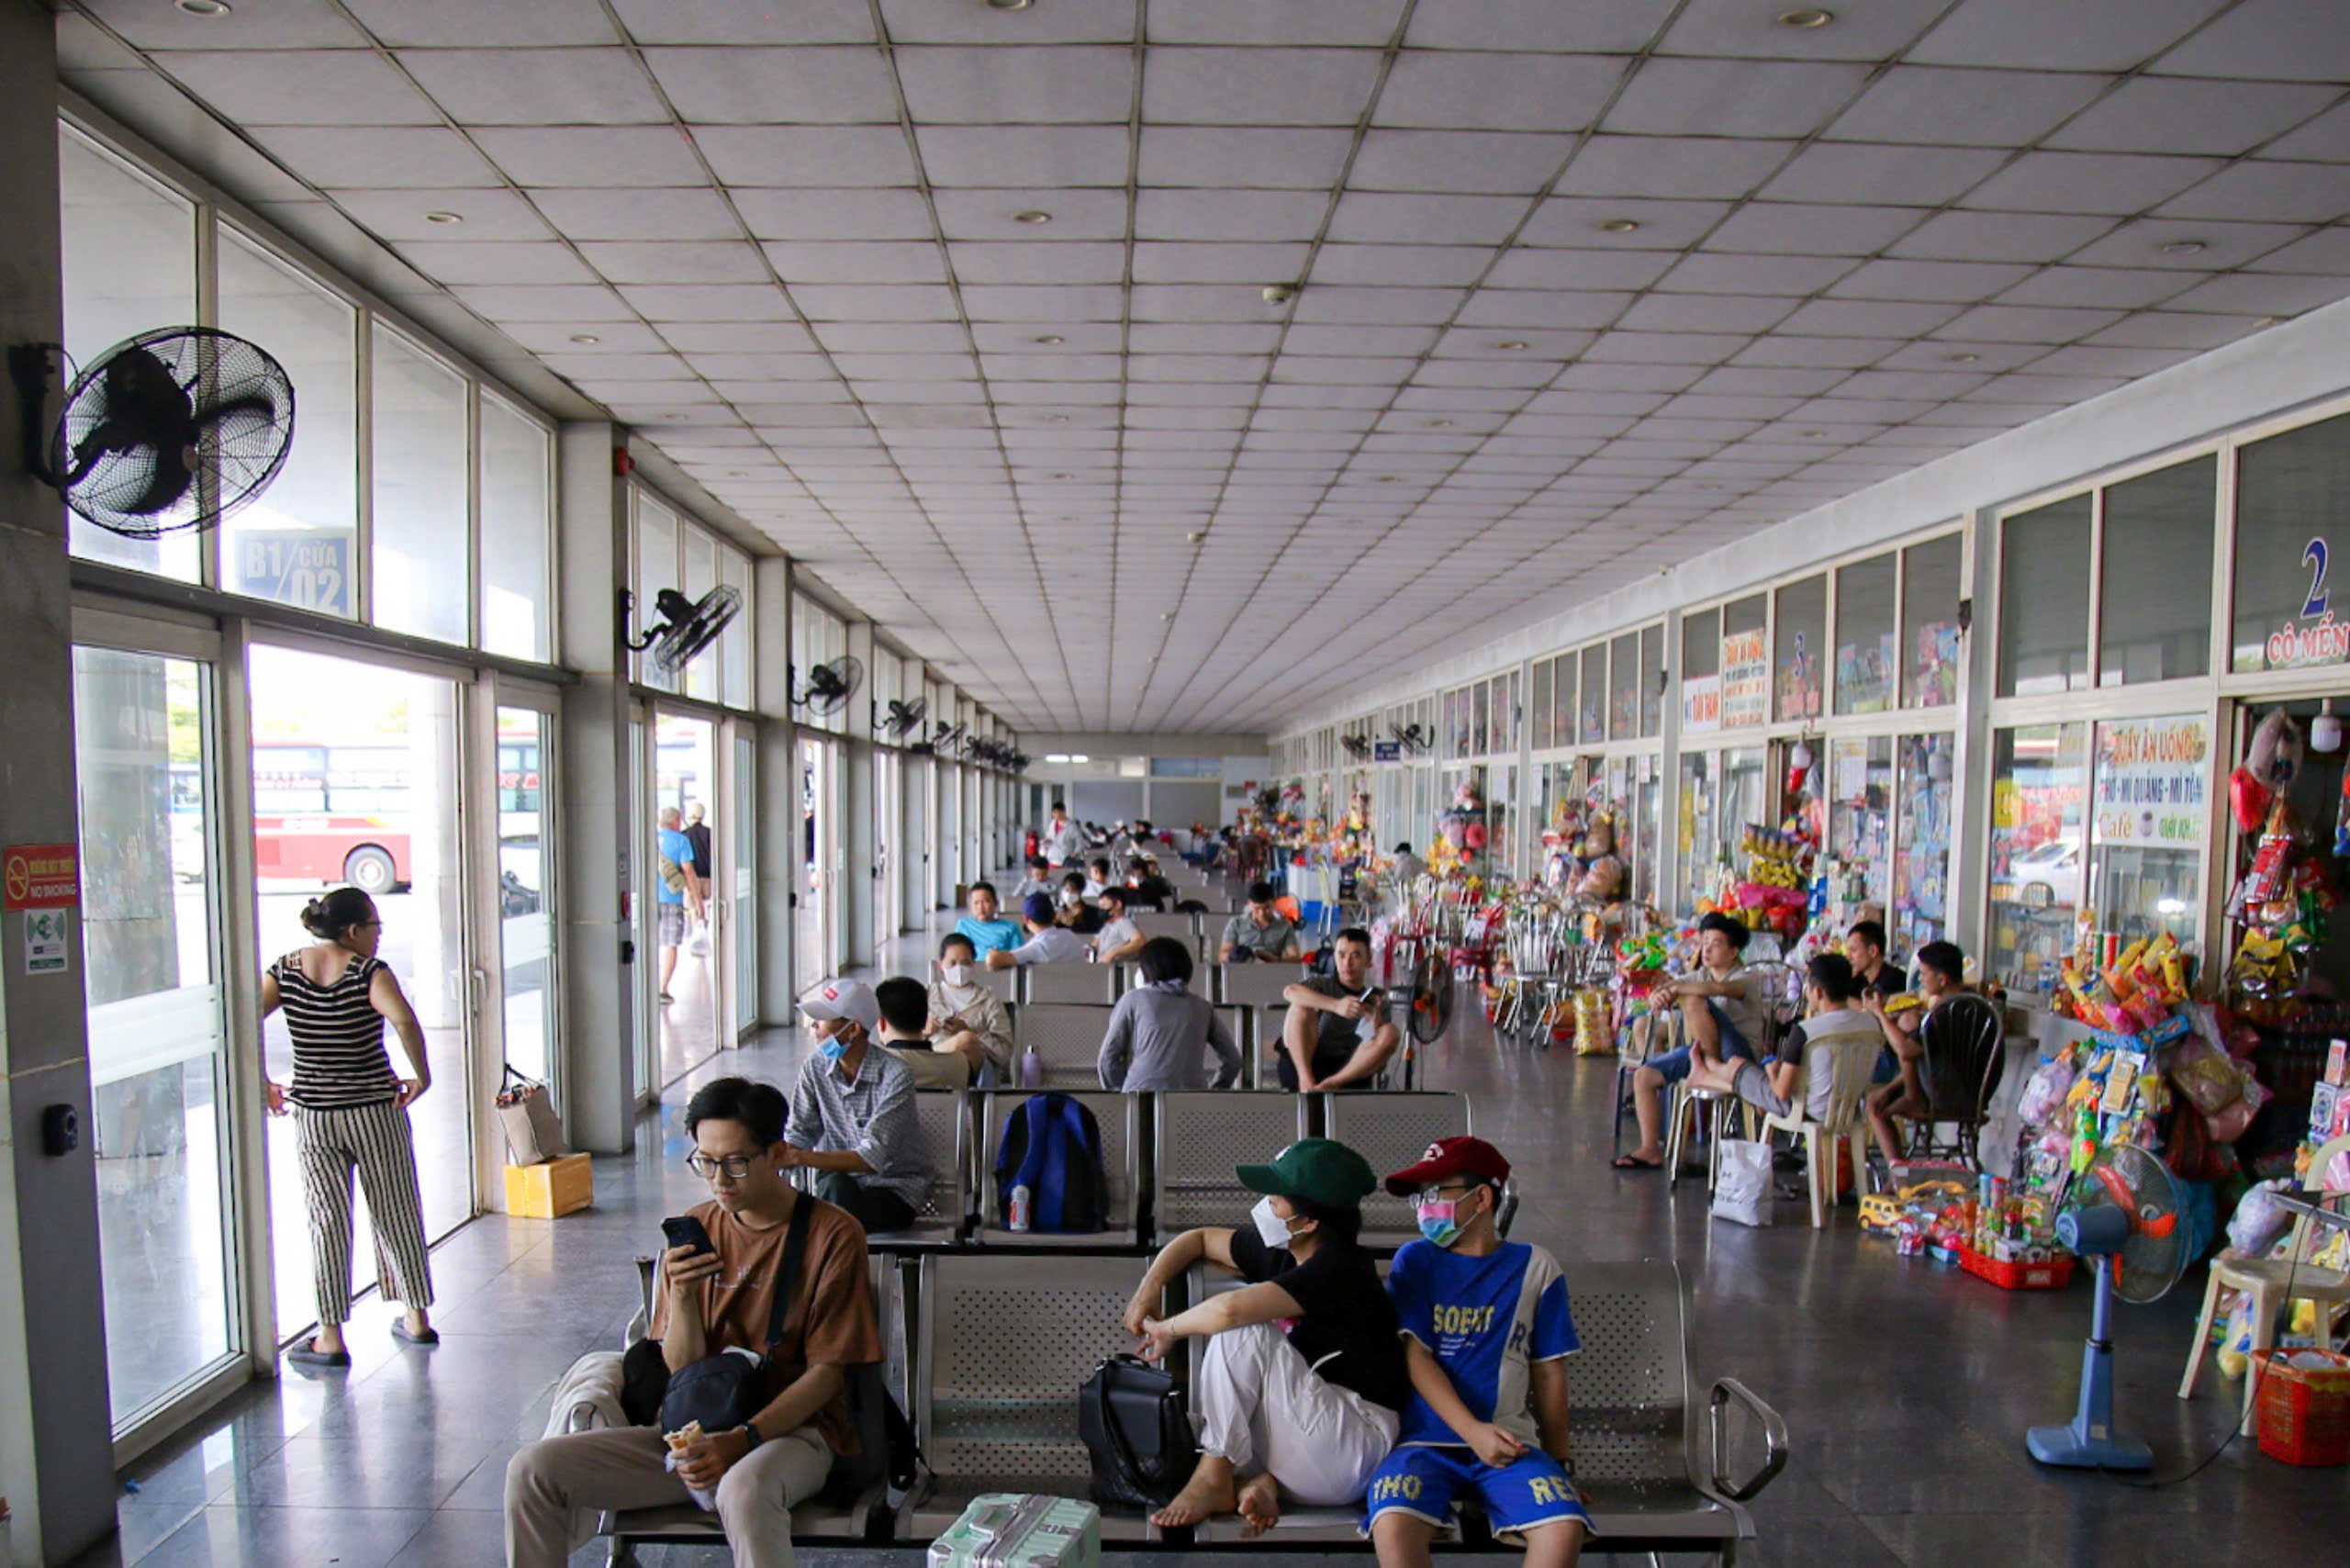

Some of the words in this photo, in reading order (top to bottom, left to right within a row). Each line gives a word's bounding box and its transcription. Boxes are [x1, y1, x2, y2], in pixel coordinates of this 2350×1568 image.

[291, 568, 342, 612] 02
[2301, 537, 2331, 620] 2
[2267, 621, 2295, 663] CÔ
